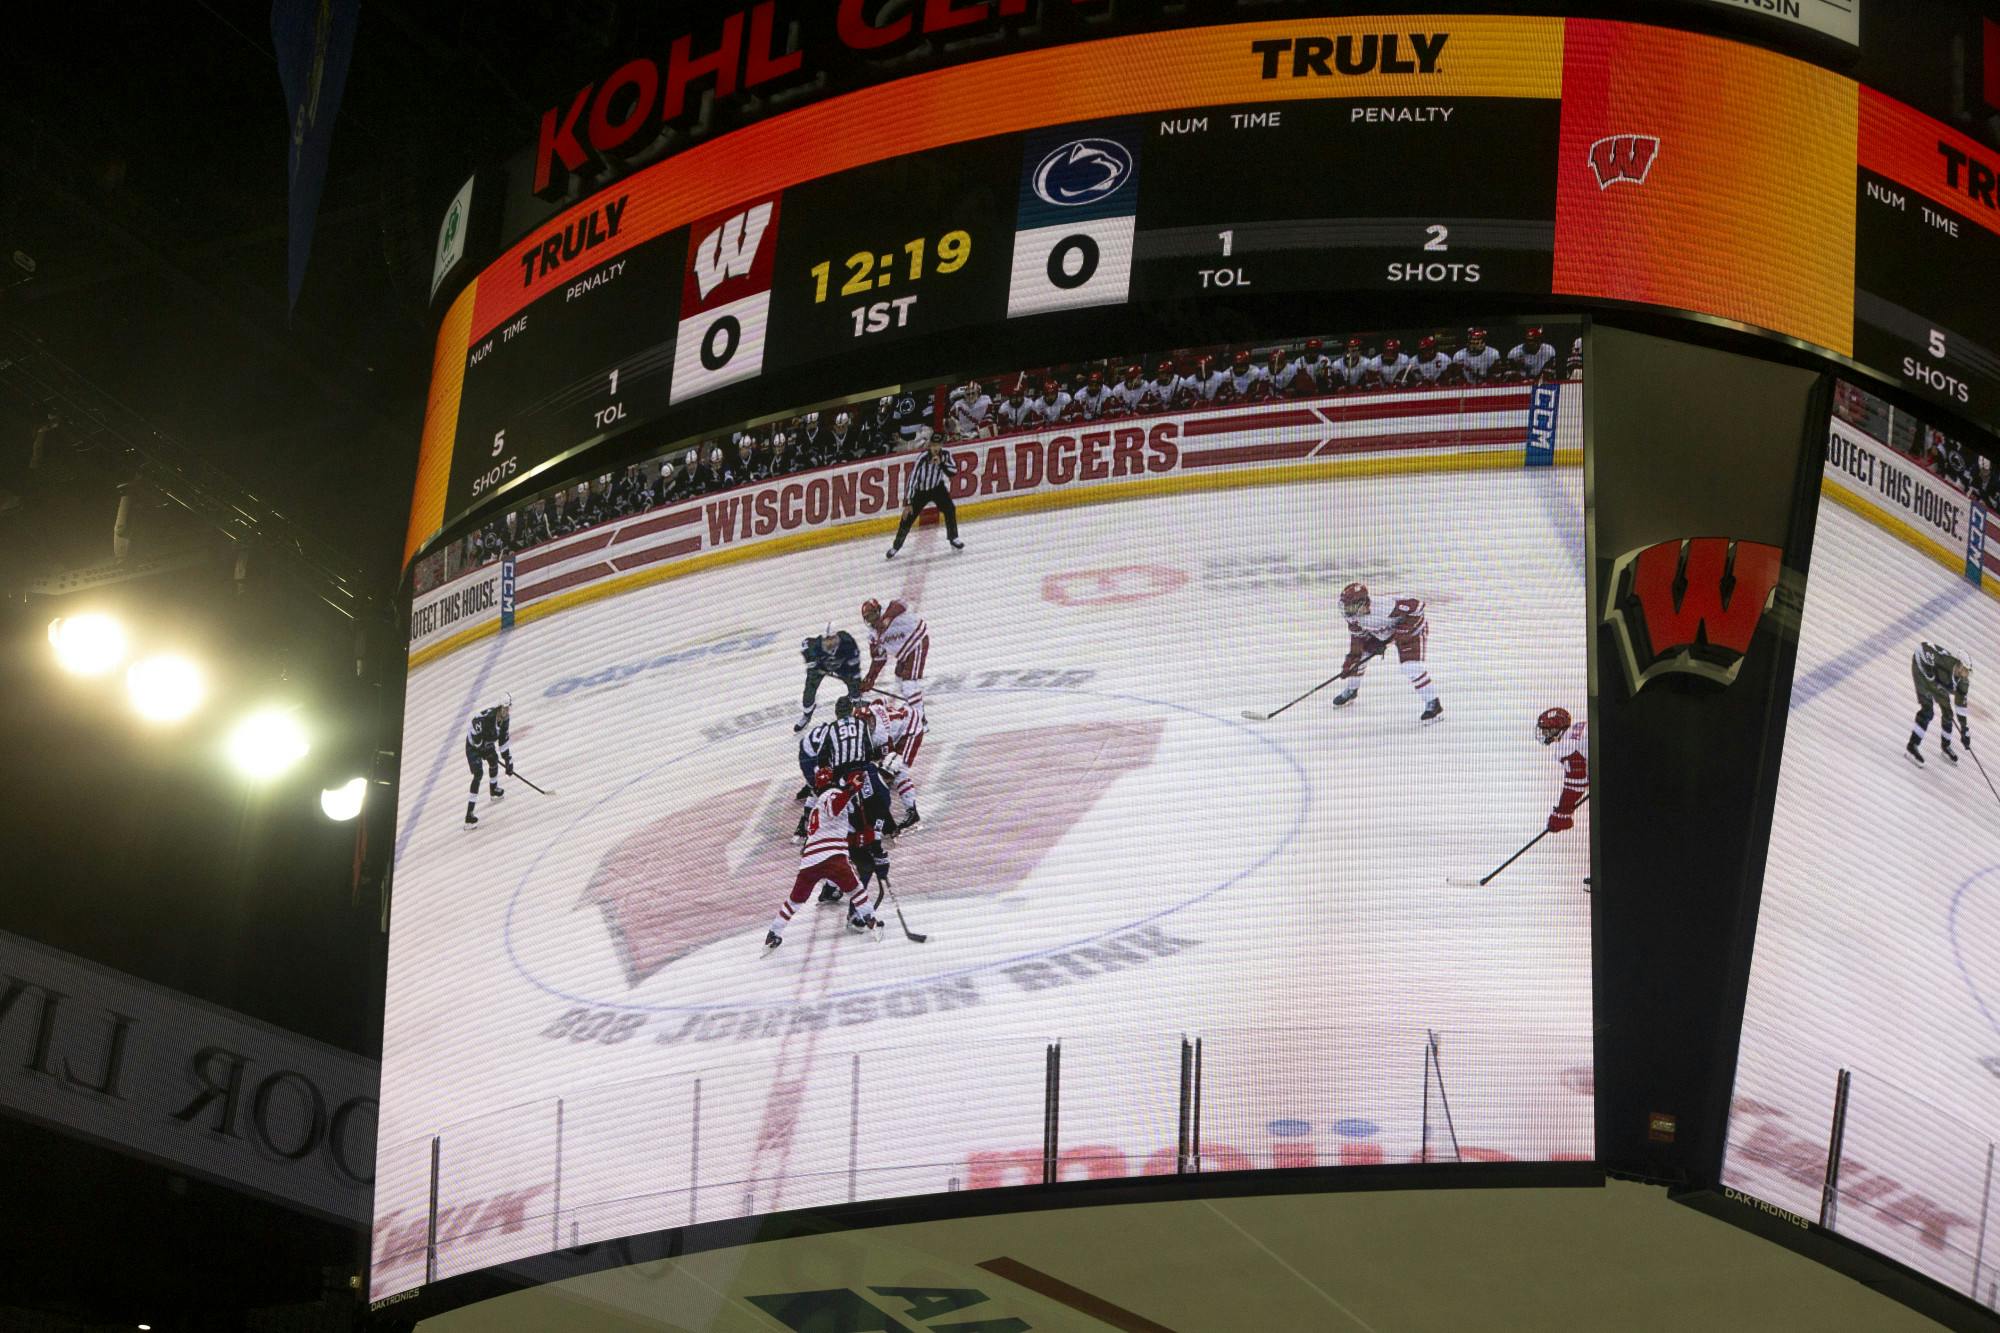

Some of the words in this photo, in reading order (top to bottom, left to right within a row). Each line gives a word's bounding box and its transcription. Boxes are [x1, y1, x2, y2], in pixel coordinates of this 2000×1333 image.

[1252, 34, 1449, 79] TRULY
[534, 1, 802, 195] KOHL
[1160, 117, 1208, 136] NUM
[1230, 111, 1281, 129] TIME
[1351, 107, 1454, 123] PENALTY
[1937, 140, 2000, 210] TR
[1867, 181, 1906, 211] NUM
[1922, 207, 1959, 238] TIME
[520, 195, 628, 288] TRULY
[696, 201, 773, 301] W
[1218, 230, 1233, 257] 1
[1423, 224, 1448, 251] 2
[566, 261, 626, 302] PENALTY
[811, 230, 972, 303] 12:19
[1047, 234, 1100, 289] 0
[1199, 268, 1251, 288] TOL
[1387, 262, 1480, 283] SHOTS
[851, 296, 917, 336] 1ST
[470, 341, 493, 367] NUM
[503, 315, 528, 343] TIME
[700, 315, 741, 371] 0
[1928, 329, 1946, 358] 5
[609, 369, 619, 395] 1
[1903, 357, 1969, 403] SHOTS
[594, 403, 627, 429] TOL
[1530, 388, 1556, 449] CCM
[491, 429, 505, 457] 5
[950, 422, 1179, 499] BADGERS
[472, 457, 517, 497] SHOTS
[1880, 460, 1912, 509] THIS
[503, 562, 514, 613] CCM
[411, 602, 438, 640] OTECT
[440, 592, 461, 628] THIS
[1724, 1187, 1809, 1231] DAKTRONICS
[371, 1287, 420, 1312] DAKTRONICS
